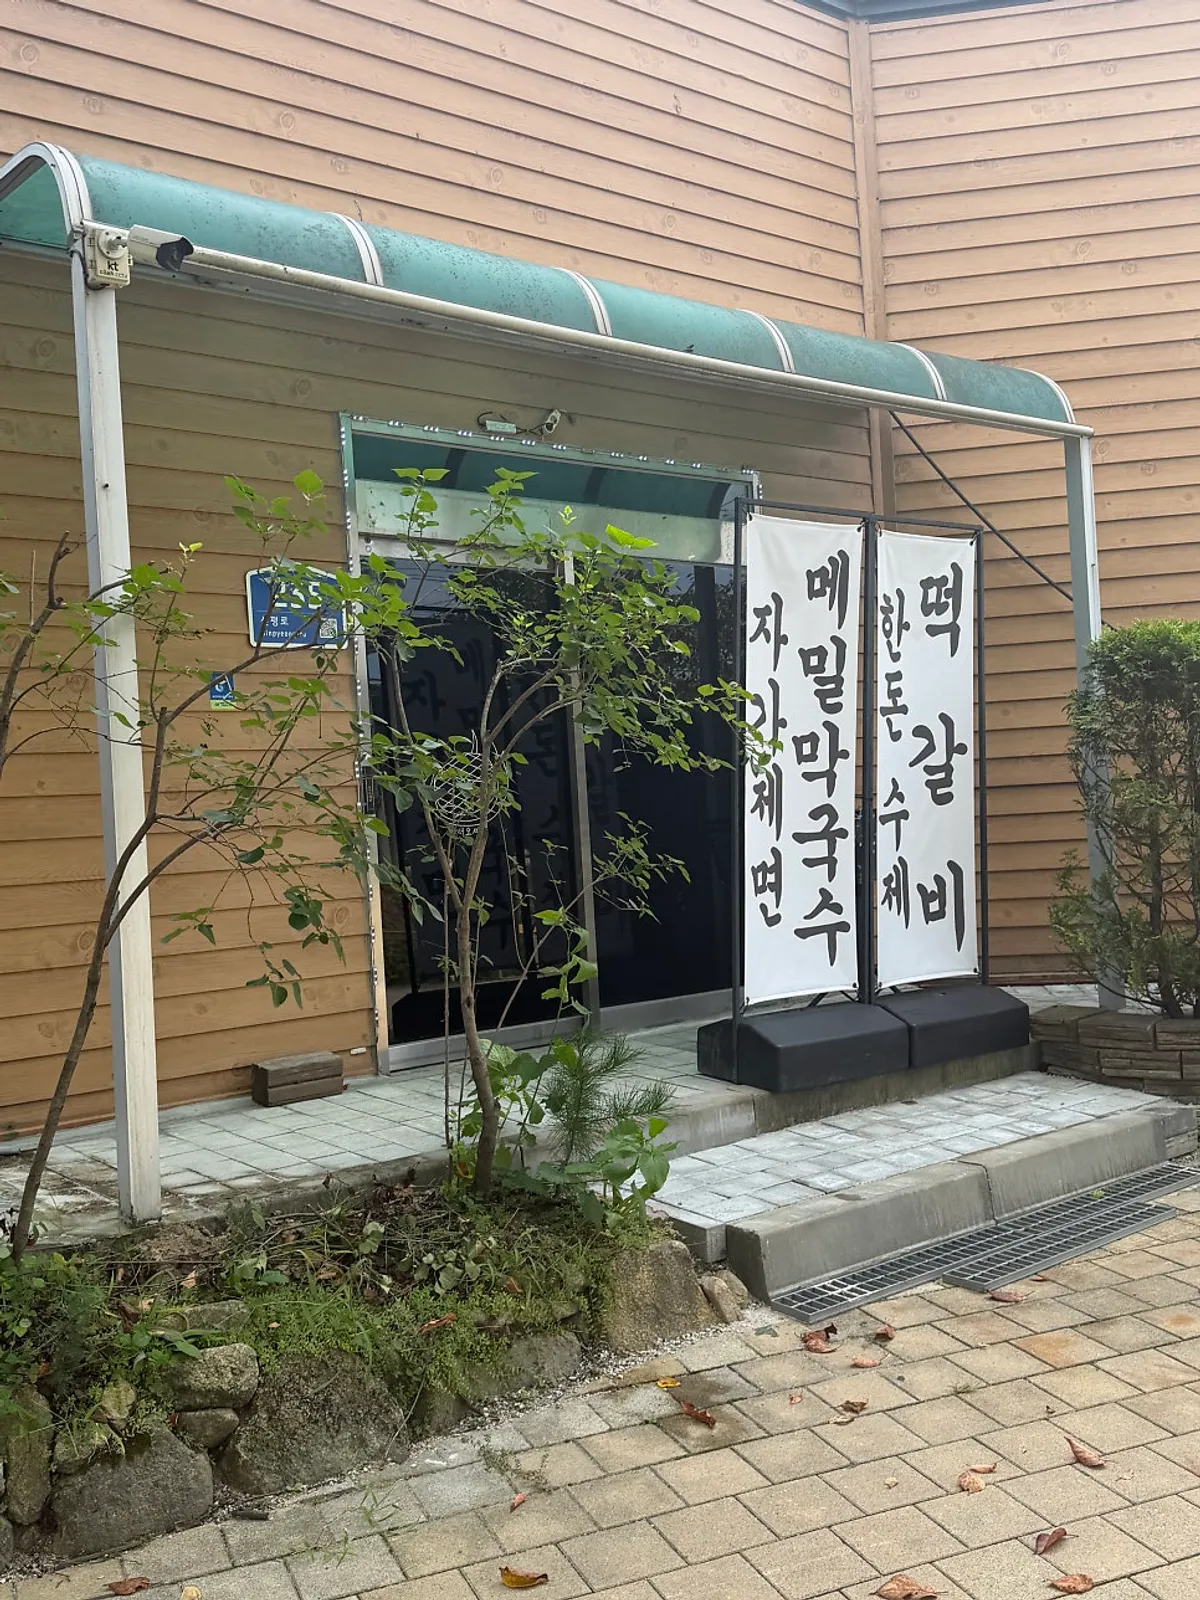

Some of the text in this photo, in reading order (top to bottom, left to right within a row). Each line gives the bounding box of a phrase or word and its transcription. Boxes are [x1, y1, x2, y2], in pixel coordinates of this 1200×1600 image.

[107, 260, 119, 272] kt
[749, 591, 789, 928] 자가제면
[791, 549, 850, 967] 메밀막국수
[908, 561, 968, 953] 떡갈비
